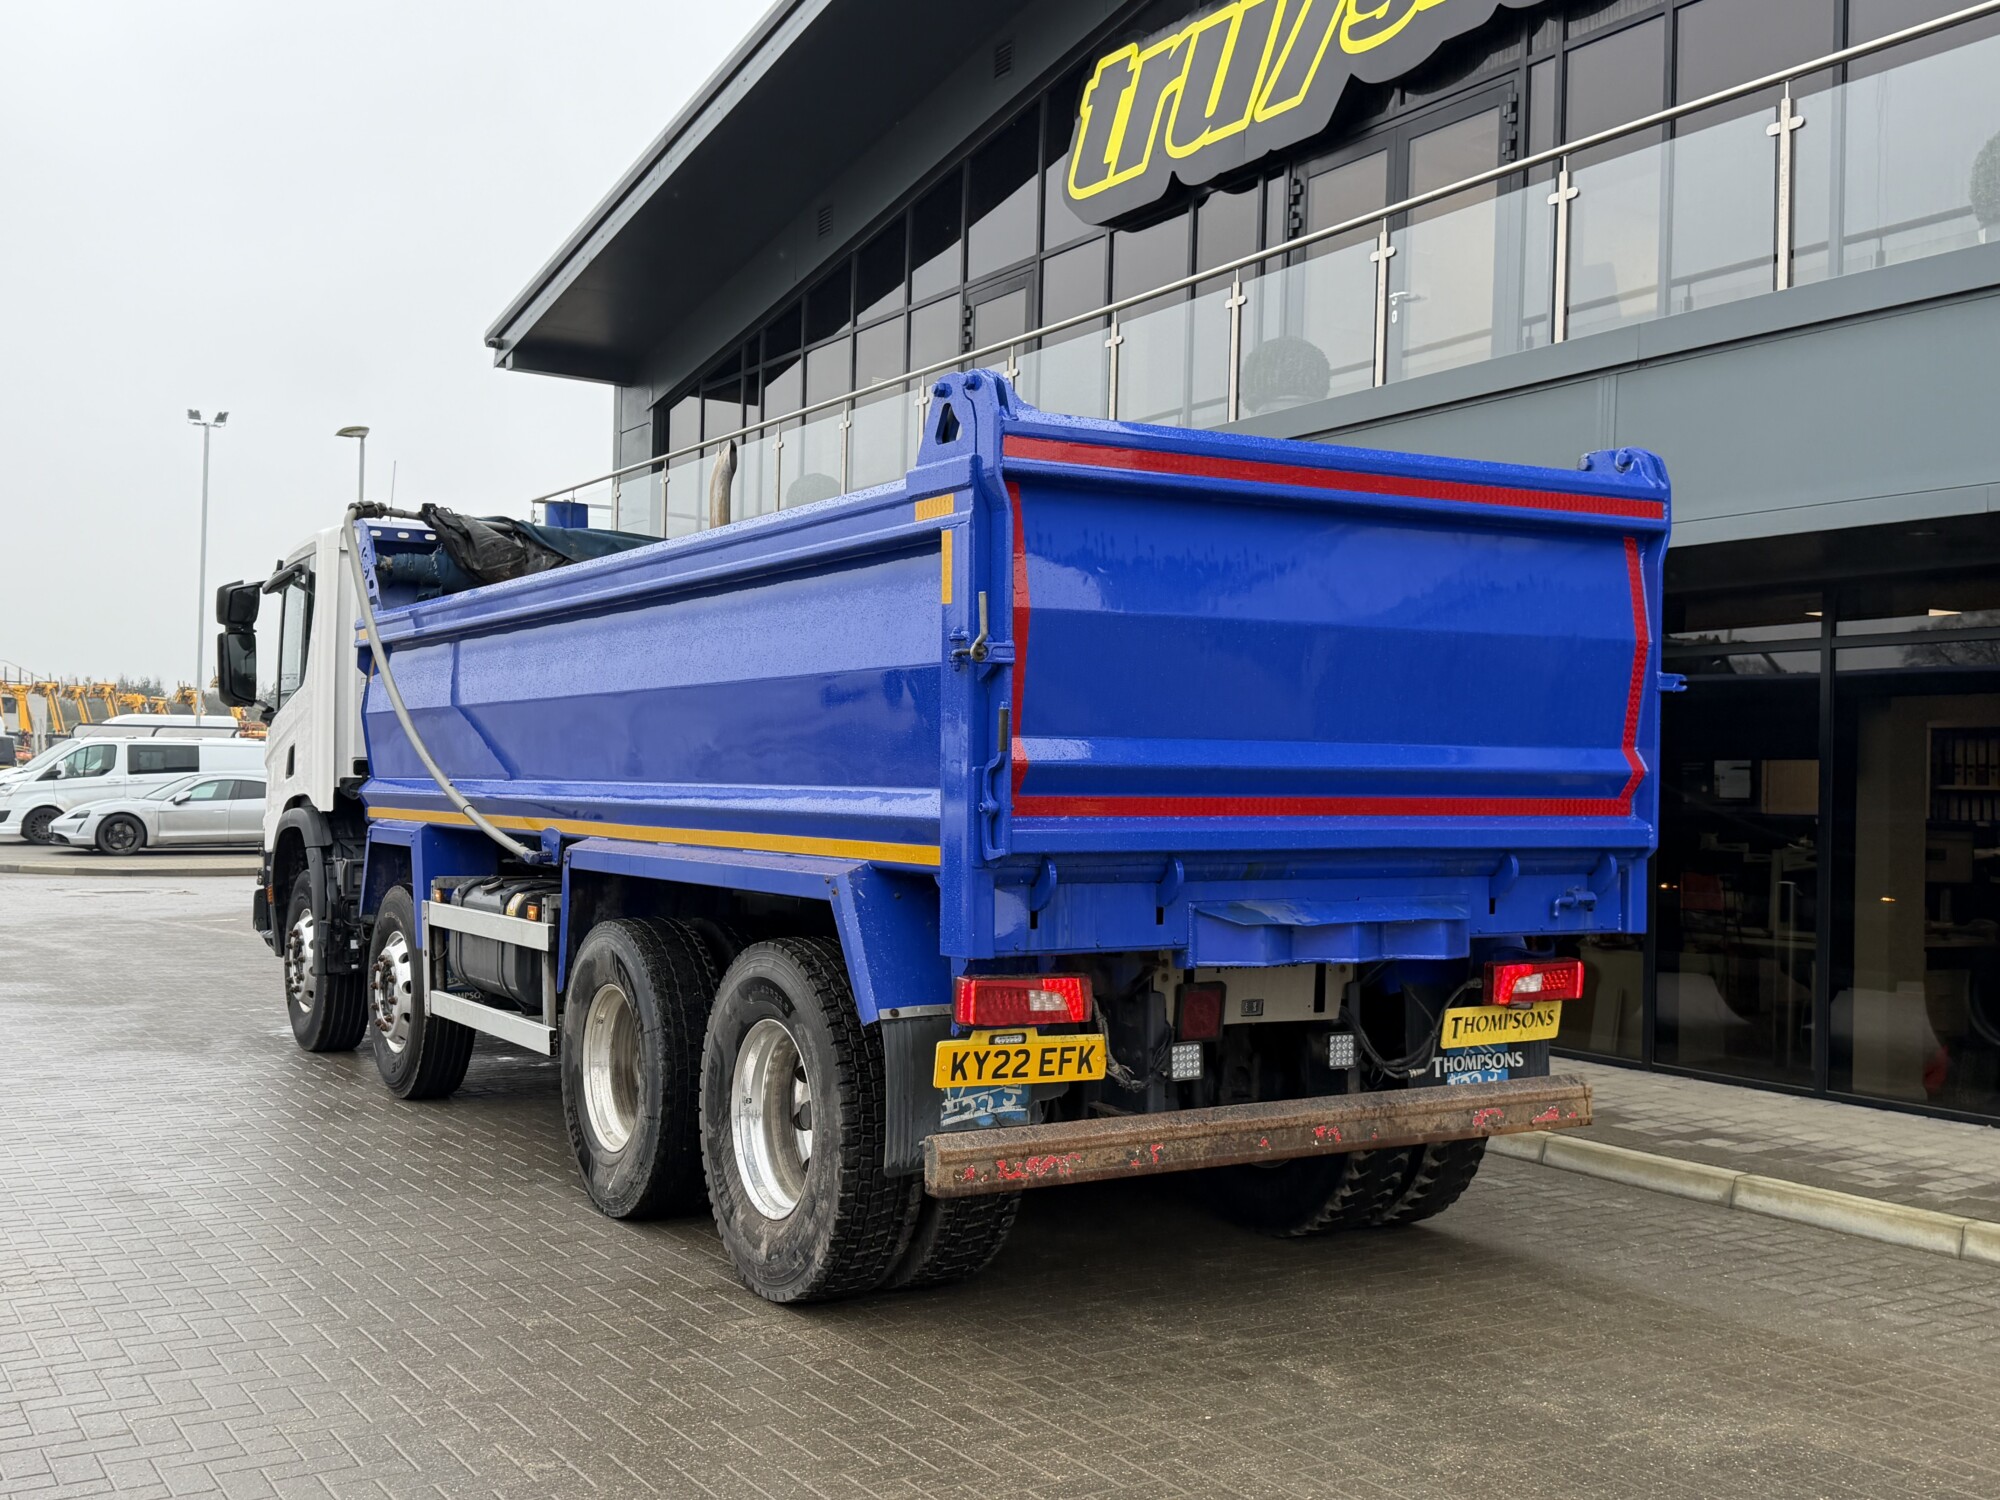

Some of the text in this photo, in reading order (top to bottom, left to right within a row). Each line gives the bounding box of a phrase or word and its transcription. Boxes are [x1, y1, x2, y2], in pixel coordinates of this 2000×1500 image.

[1451, 1010, 1555, 1039] THOMPSONS
[950, 1045, 1096, 1081] KY22 EFK
[1432, 1052, 1524, 1078] THOMPSONS
